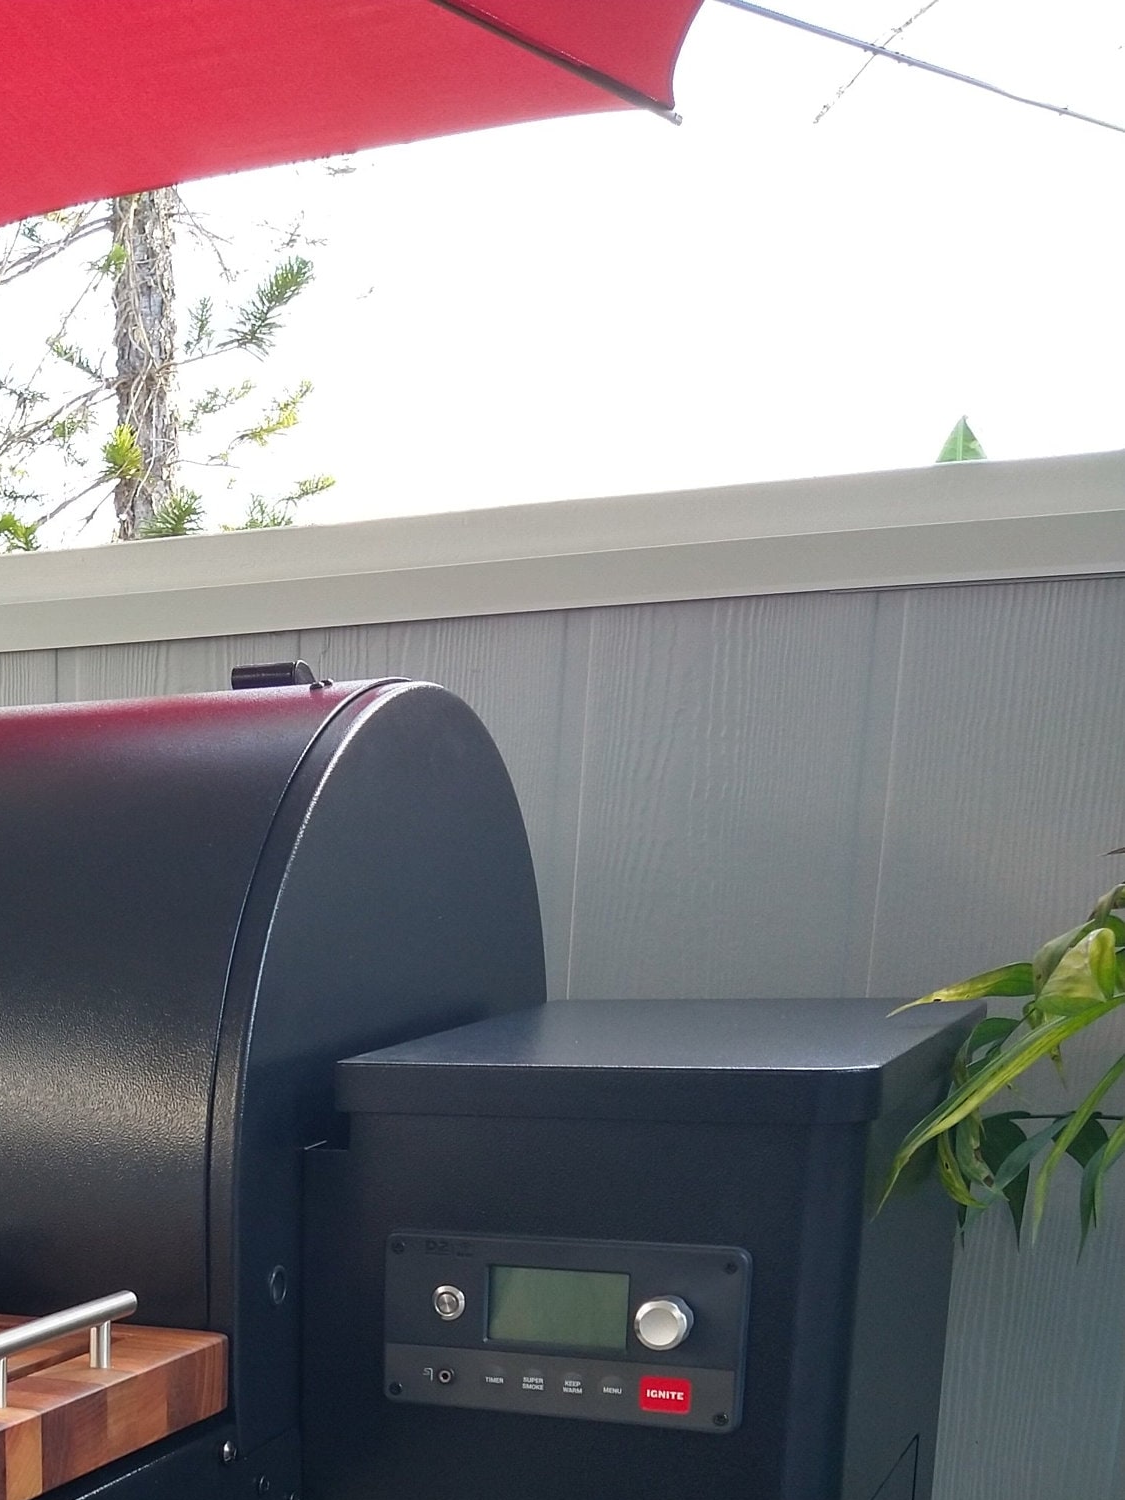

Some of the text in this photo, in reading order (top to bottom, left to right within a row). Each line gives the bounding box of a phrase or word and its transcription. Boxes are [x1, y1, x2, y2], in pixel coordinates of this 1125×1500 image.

[485, 1376, 504, 1384] TIMER
[522, 1376, 544, 1384] SUPER
[564, 1379, 581, 1387] KEEP
[522, 1383, 544, 1391] SMOKE
[562, 1386, 583, 1394] WARM
[602, 1386, 622, 1395] MENU
[646, 1389, 684, 1401] IGNITE
